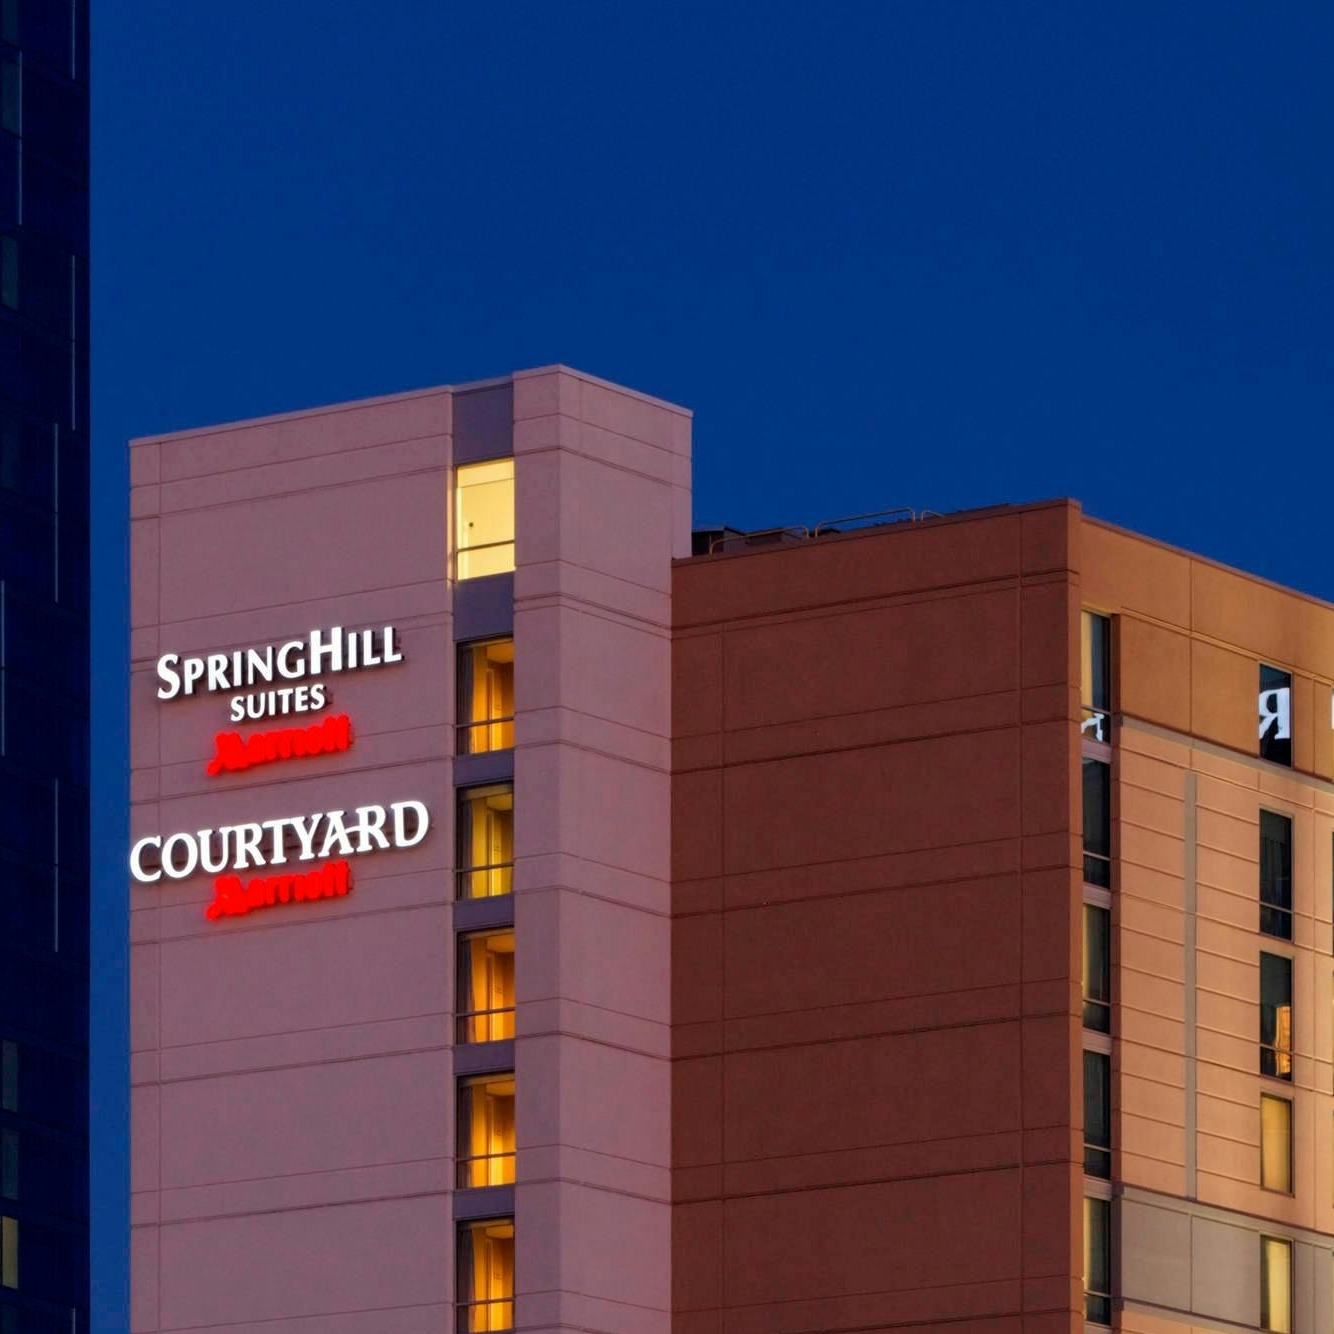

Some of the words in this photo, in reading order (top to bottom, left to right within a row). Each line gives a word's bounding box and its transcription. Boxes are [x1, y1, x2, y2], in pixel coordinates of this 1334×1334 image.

[156, 626, 403, 699] SPRINGHILL
[230, 683, 326, 722] SUITES
[129, 800, 430, 883] COURTYARD
